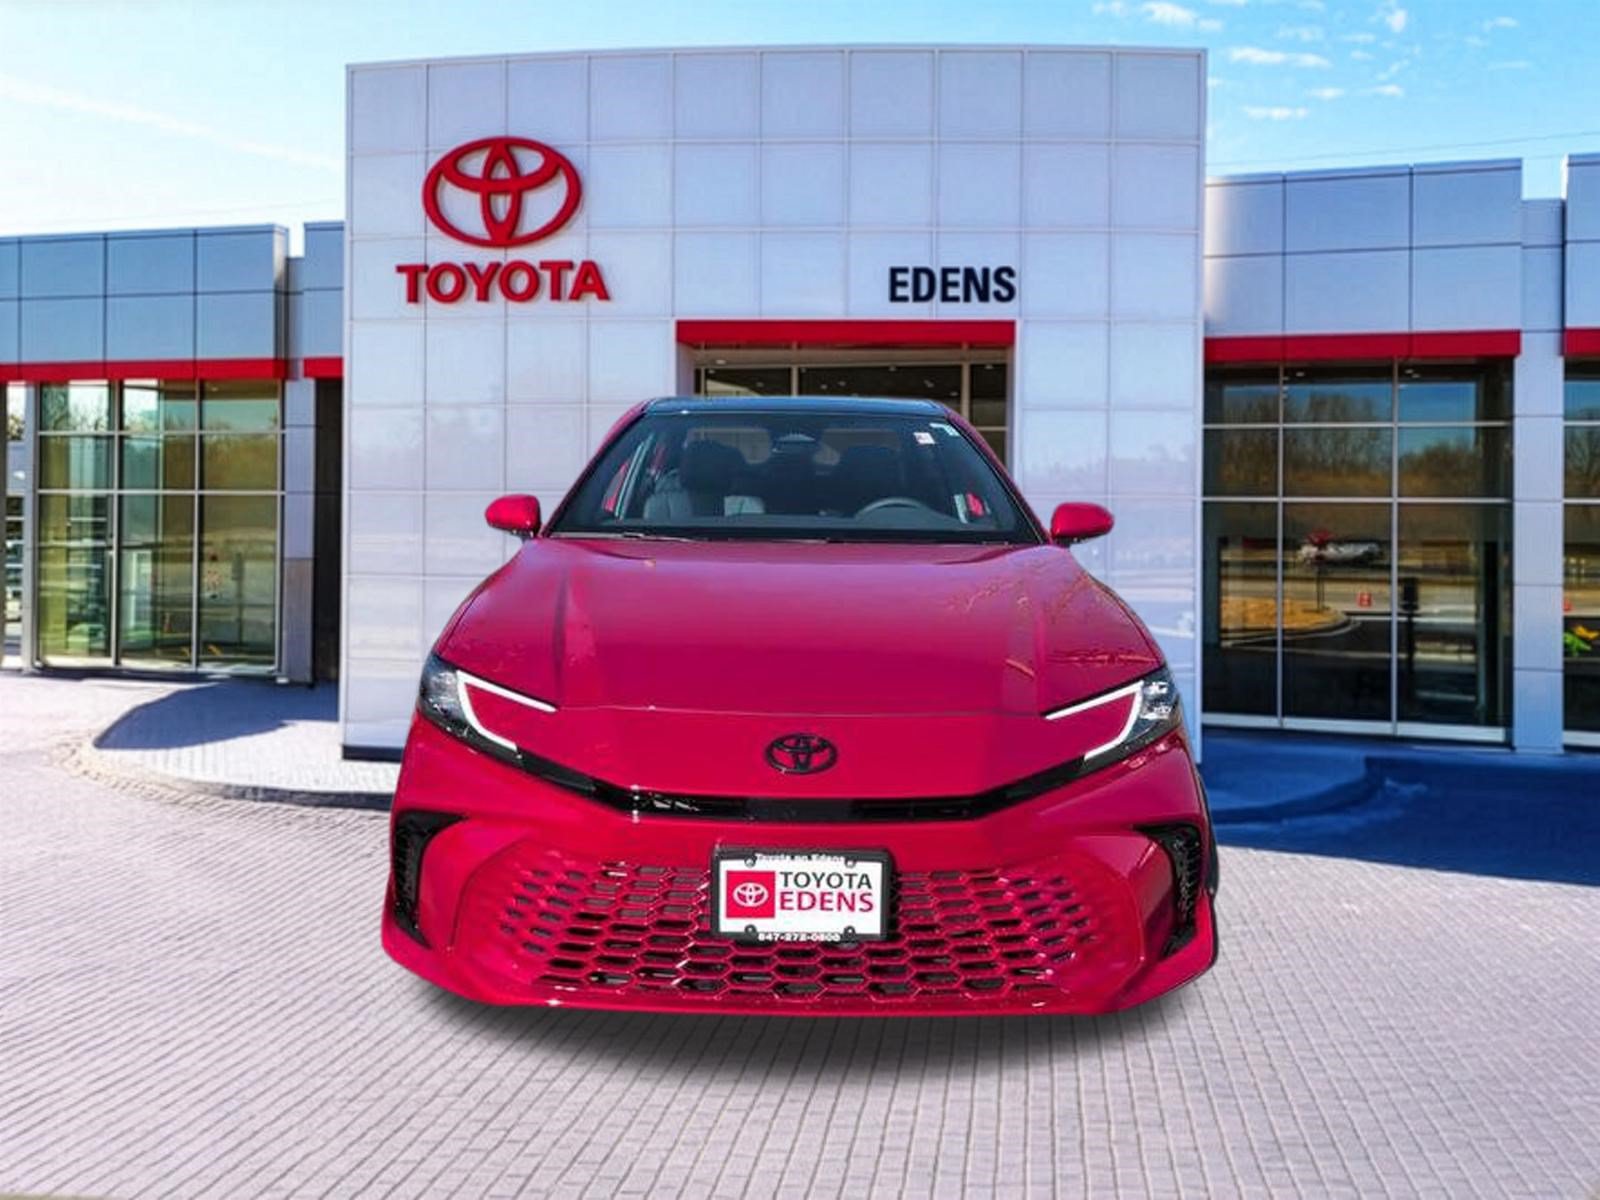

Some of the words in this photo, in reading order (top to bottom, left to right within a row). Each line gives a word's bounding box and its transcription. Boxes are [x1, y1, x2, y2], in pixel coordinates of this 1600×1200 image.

[396, 260, 610, 304] TOYOTA
[889, 266, 1016, 303] EDENS
[779, 871, 872, 889] TOYOTA
[779, 891, 874, 912] EDENS
